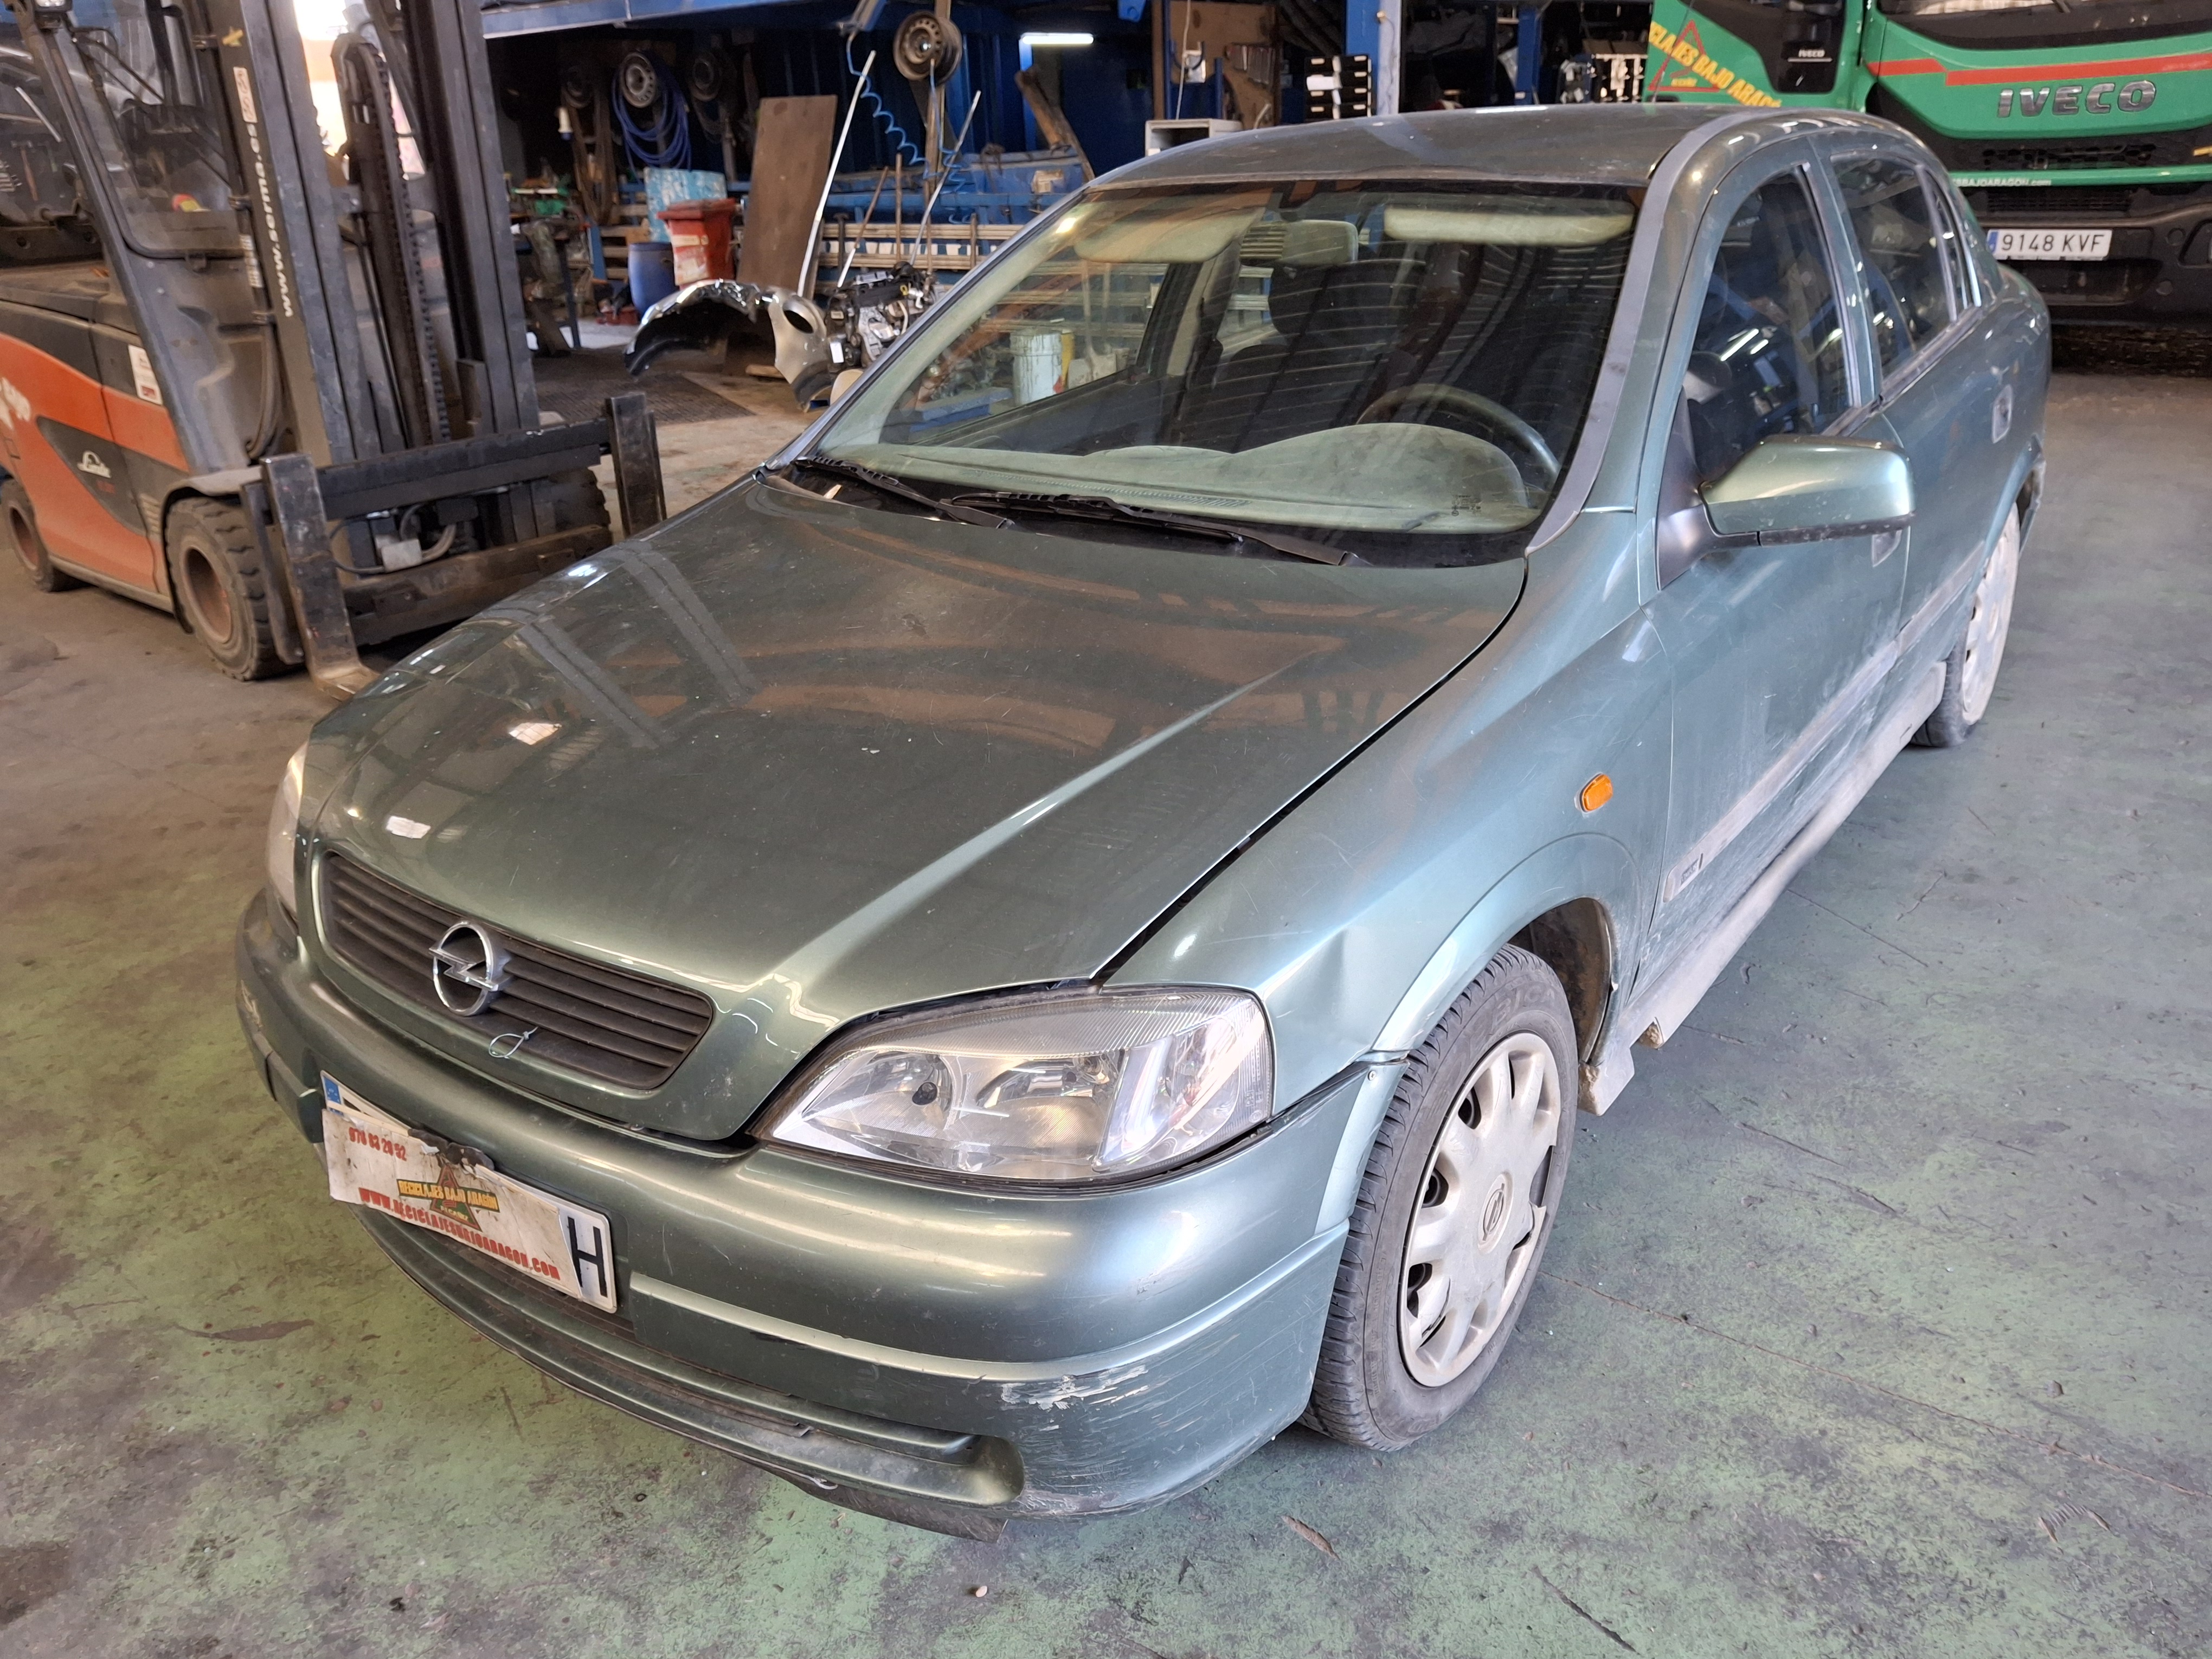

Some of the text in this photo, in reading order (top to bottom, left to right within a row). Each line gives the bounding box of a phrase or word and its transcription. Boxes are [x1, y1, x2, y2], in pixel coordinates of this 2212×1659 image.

[1692, 54, 1735, 89] BAJO
[1997, 80, 2157, 118] IVECO
[2001, 234, 2105, 252] 9148 KVF
[381, 1138, 394, 1156] 20
[394, 1143, 408, 1162] 52
[398, 1180, 444, 1199] RECICLAJES
[444, 1186, 466, 1203] BAJO
[567, 1216, 608, 1298] H
